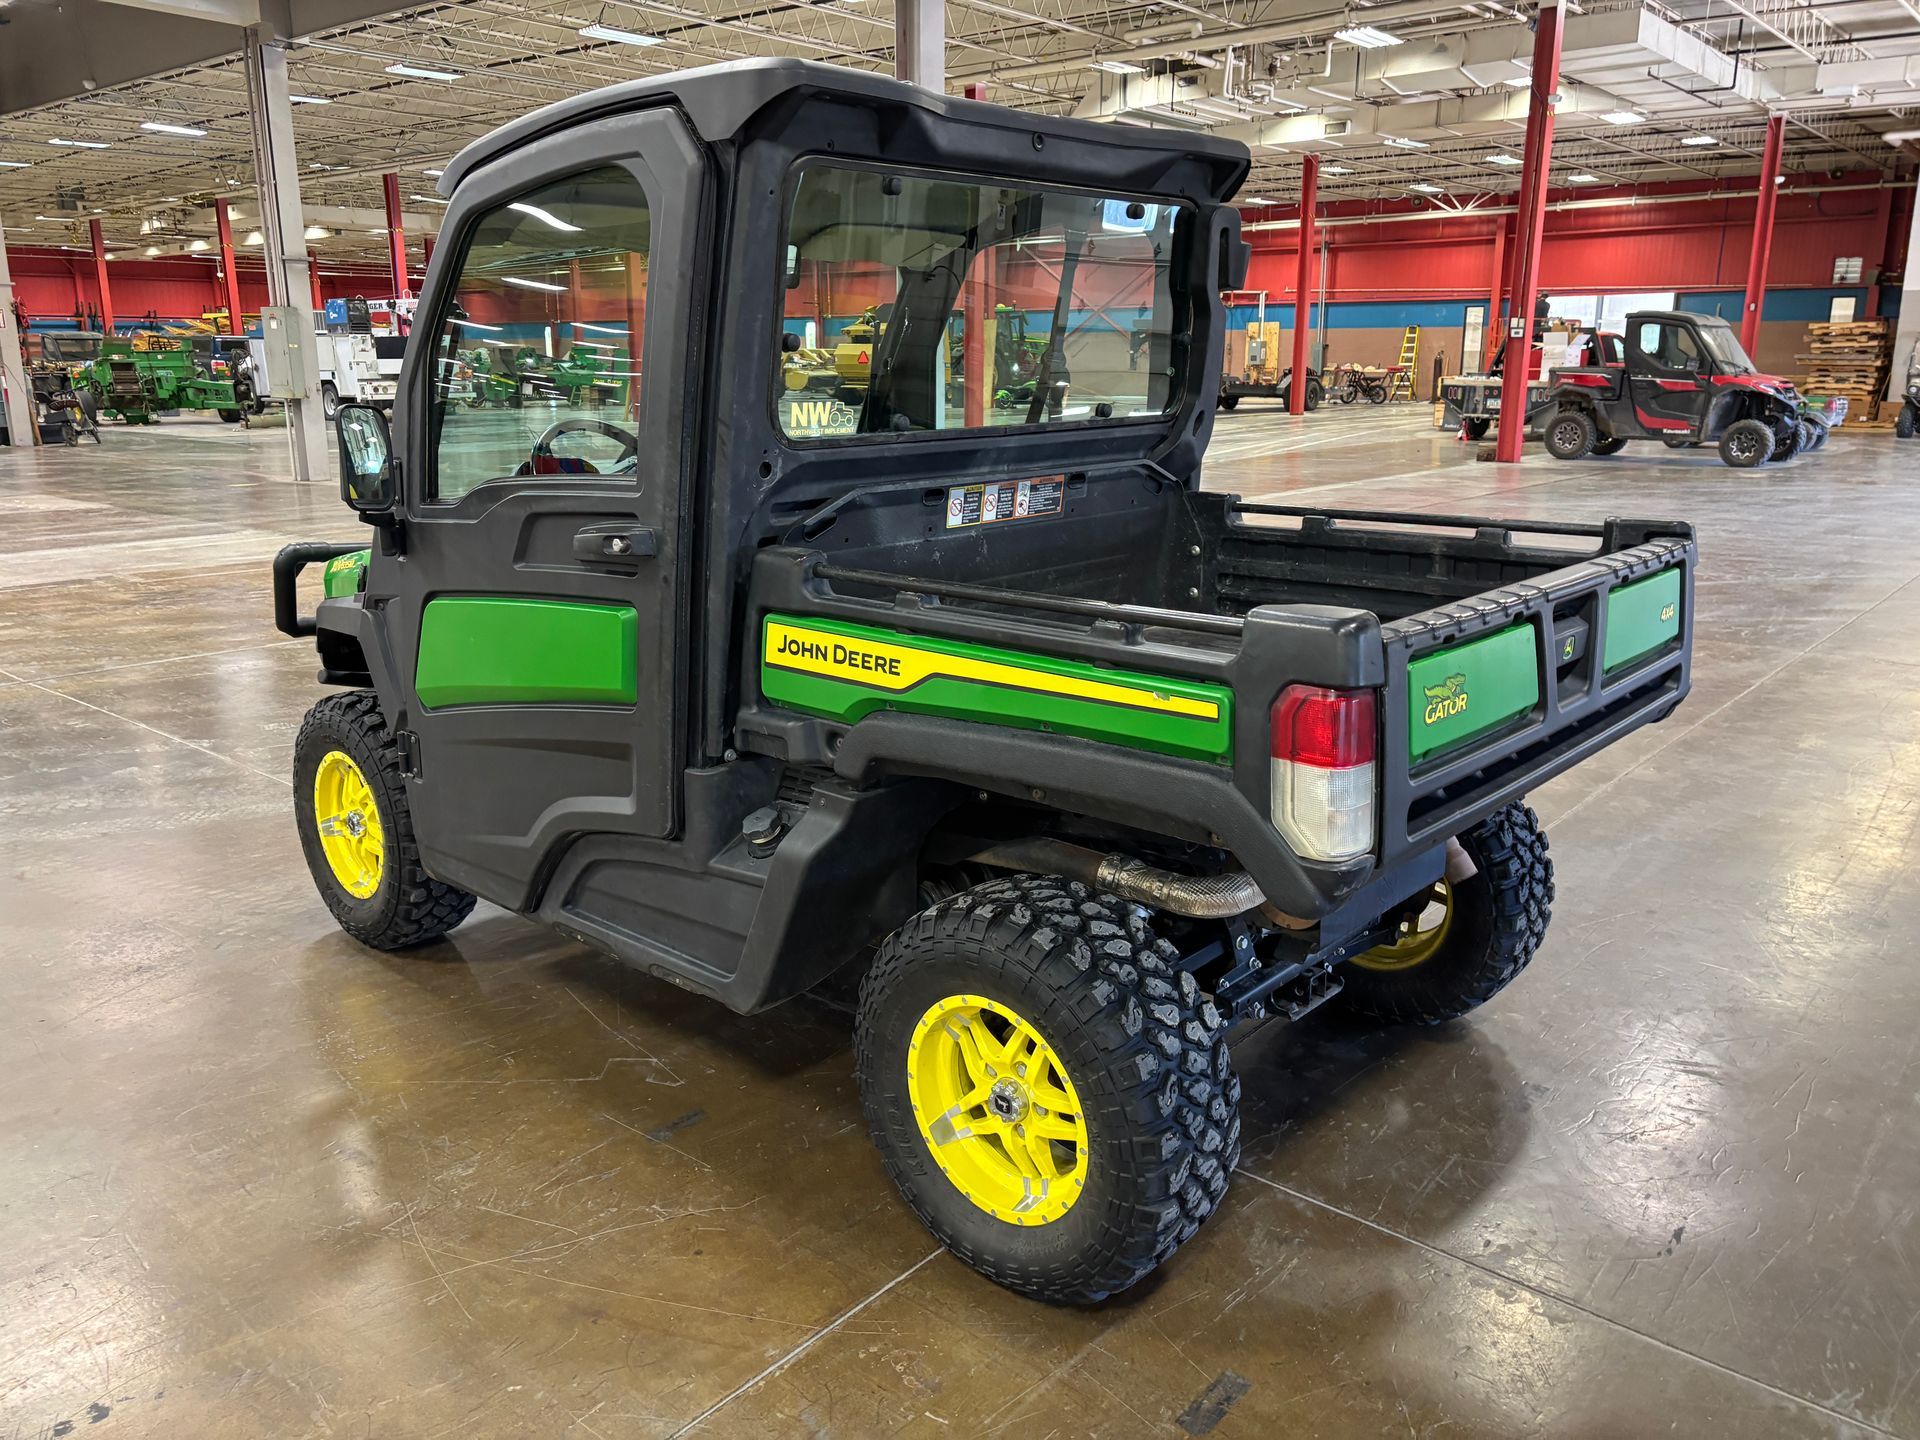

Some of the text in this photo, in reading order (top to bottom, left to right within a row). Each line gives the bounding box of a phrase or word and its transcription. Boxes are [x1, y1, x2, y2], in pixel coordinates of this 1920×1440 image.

[790, 401, 832, 428] NW
[824, 427, 854, 435] IMPLEMENT
[777, 634, 901, 677] JOHN DEERE
[1424, 693, 1468, 724] GATOR
